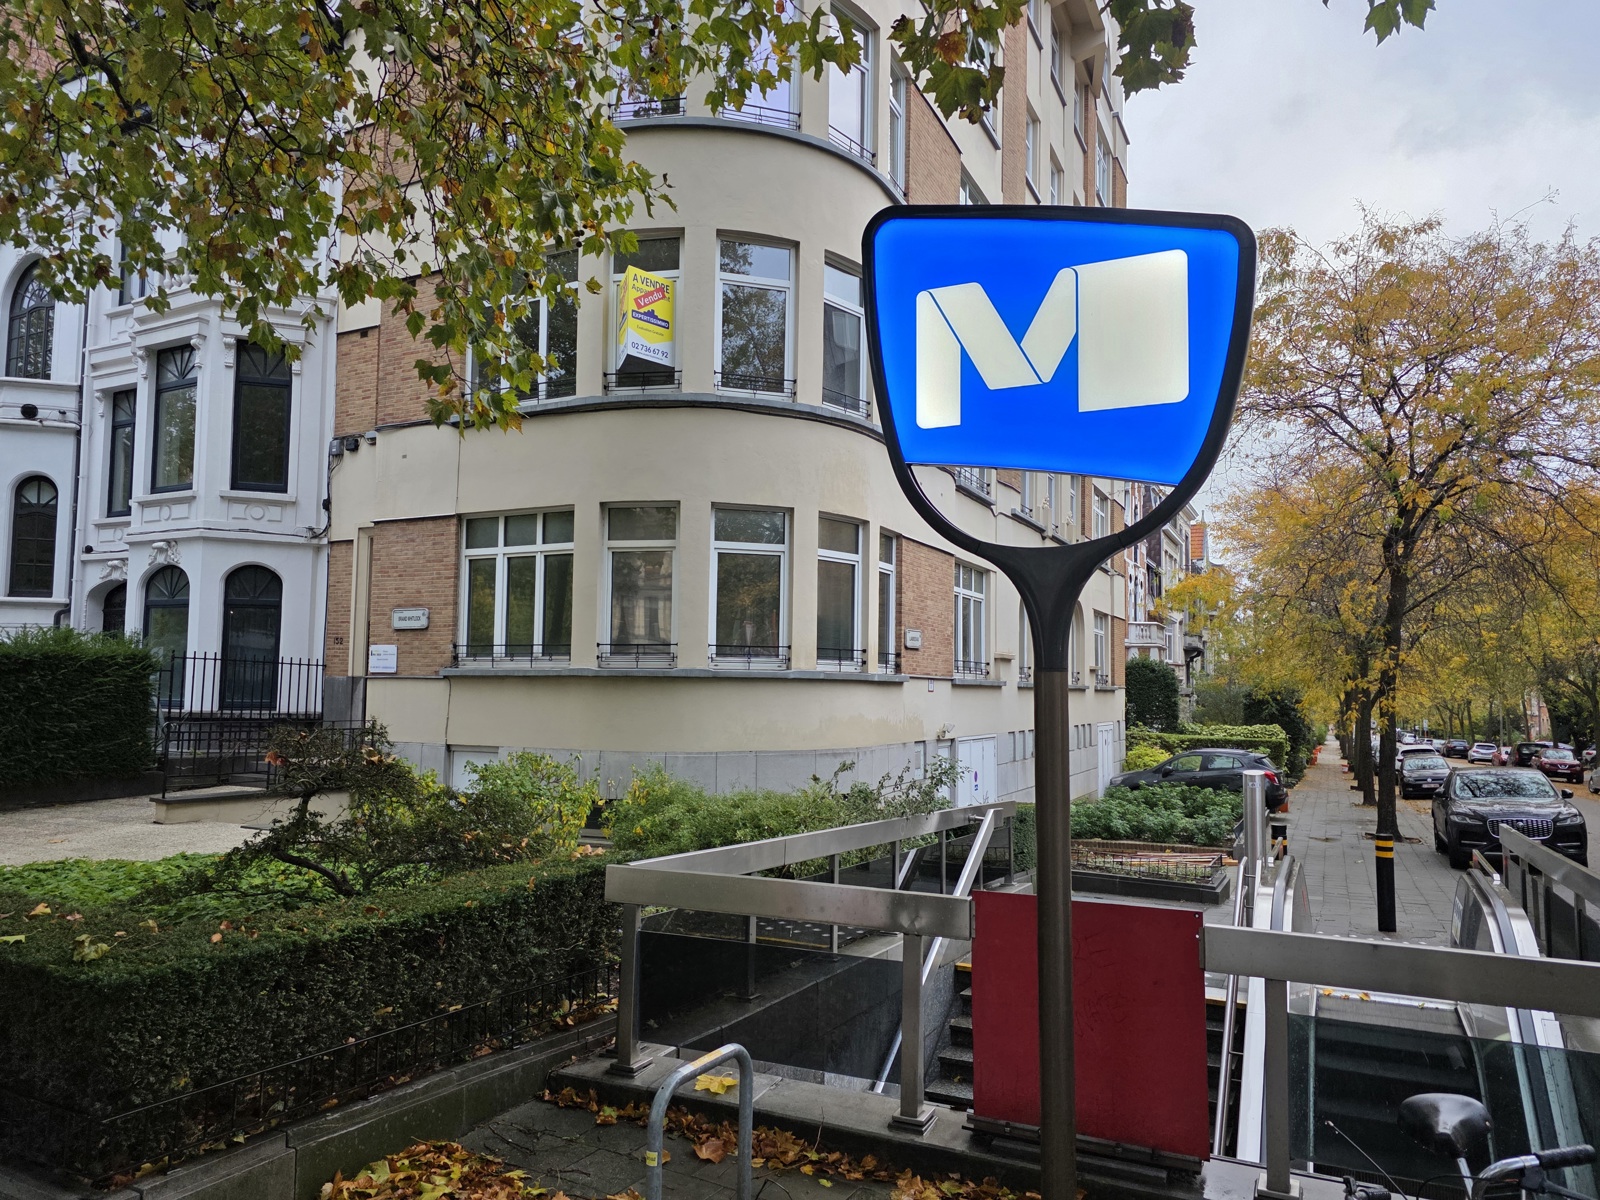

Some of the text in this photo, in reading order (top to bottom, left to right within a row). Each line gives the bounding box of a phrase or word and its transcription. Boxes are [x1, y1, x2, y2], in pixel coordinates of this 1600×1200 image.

[632, 273, 670, 295] A VENDRE
[637, 291, 663, 307] Vendu
[916, 249, 1189, 429] M
[631, 341, 640, 350] 02
[640, 343, 652, 354] 736
[652, 347, 660, 356] 67
[660, 350, 669, 359] 92
